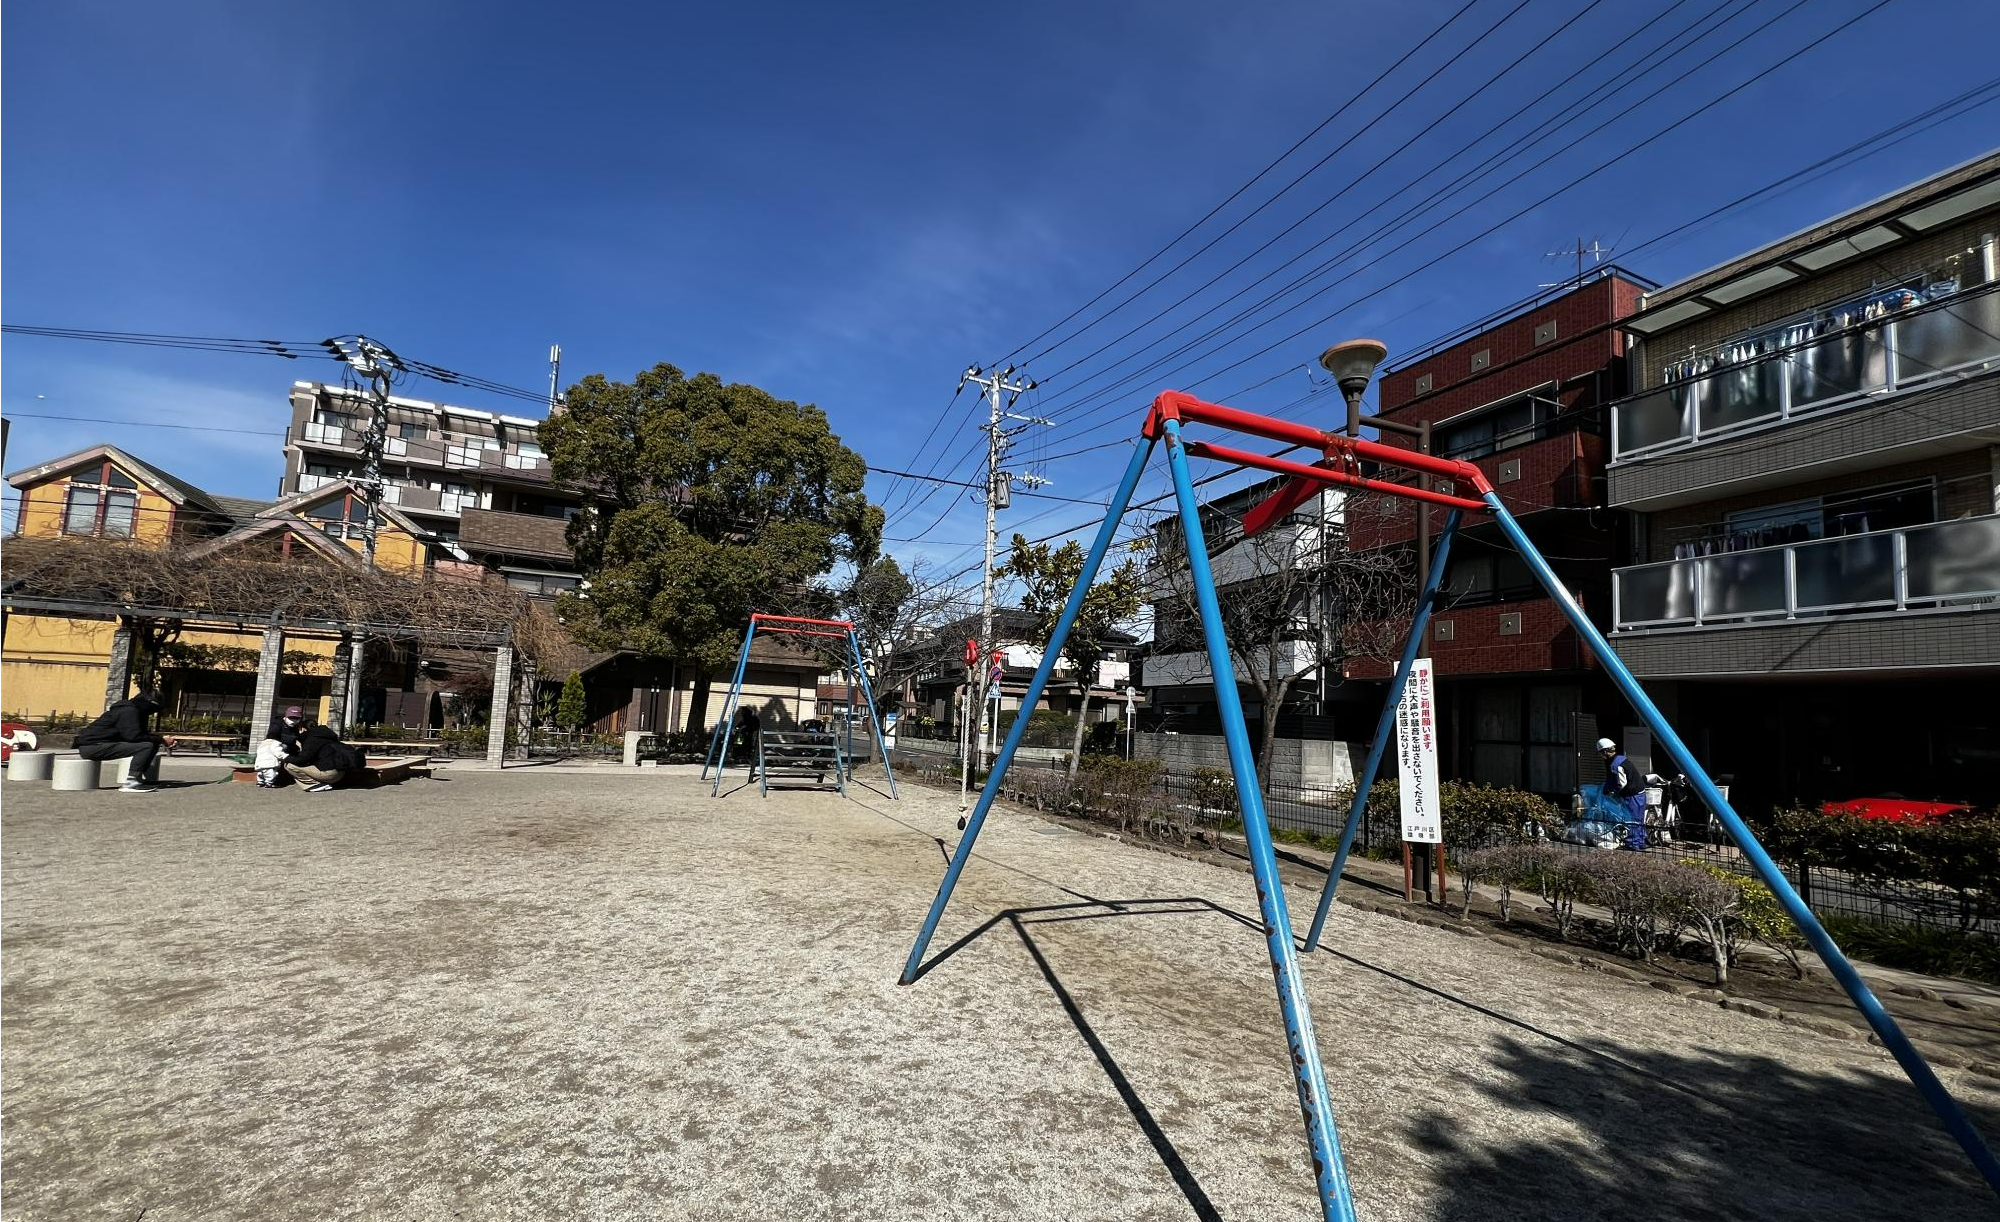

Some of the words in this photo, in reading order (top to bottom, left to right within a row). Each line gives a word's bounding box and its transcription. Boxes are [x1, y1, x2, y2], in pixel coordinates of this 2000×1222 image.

[1419, 669, 1433, 753] 静かにご利用願います。
